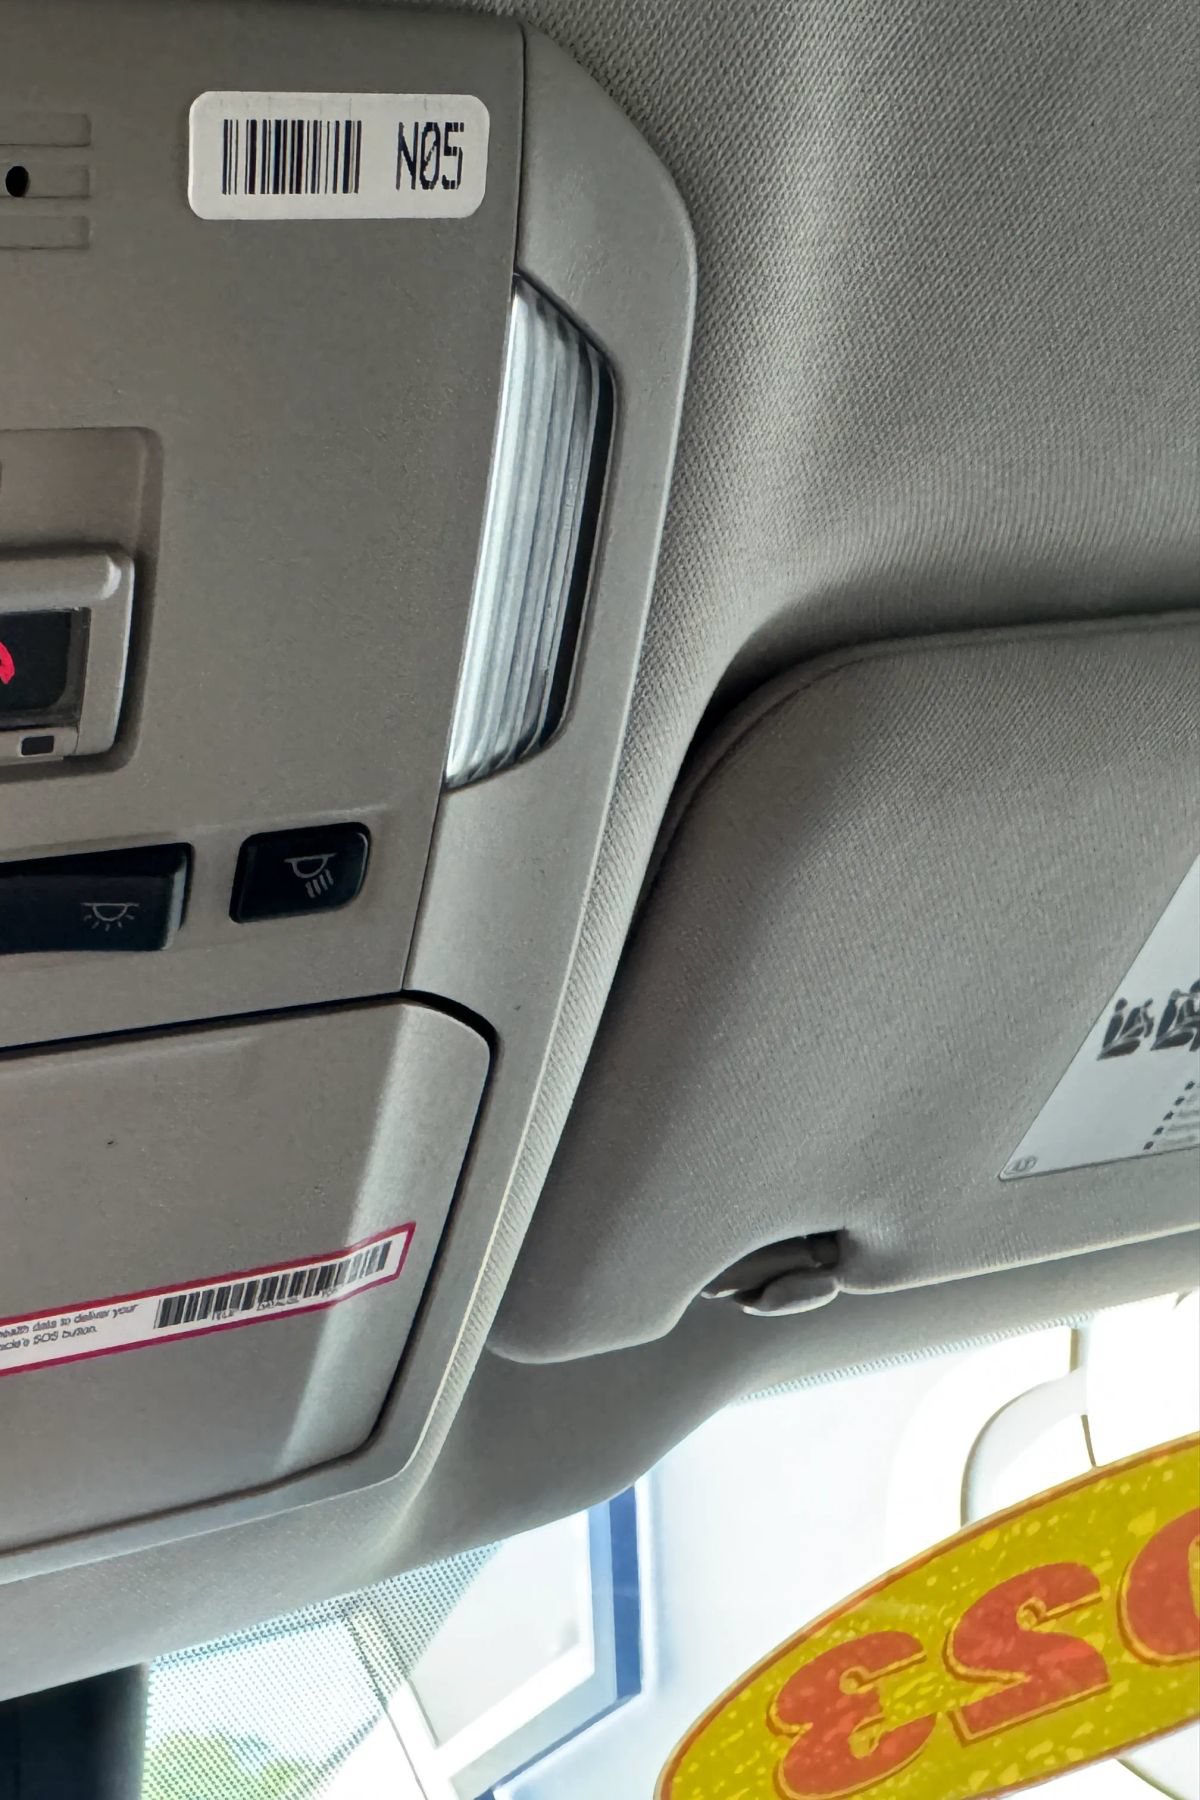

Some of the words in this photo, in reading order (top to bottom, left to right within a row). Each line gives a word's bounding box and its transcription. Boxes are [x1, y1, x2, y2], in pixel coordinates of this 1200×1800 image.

[32, 1319, 57, 1332] data
[74, 1309, 110, 1324] deliver
[112, 1304, 139, 1319] your
[33, 1331, 60, 1345] SOS
